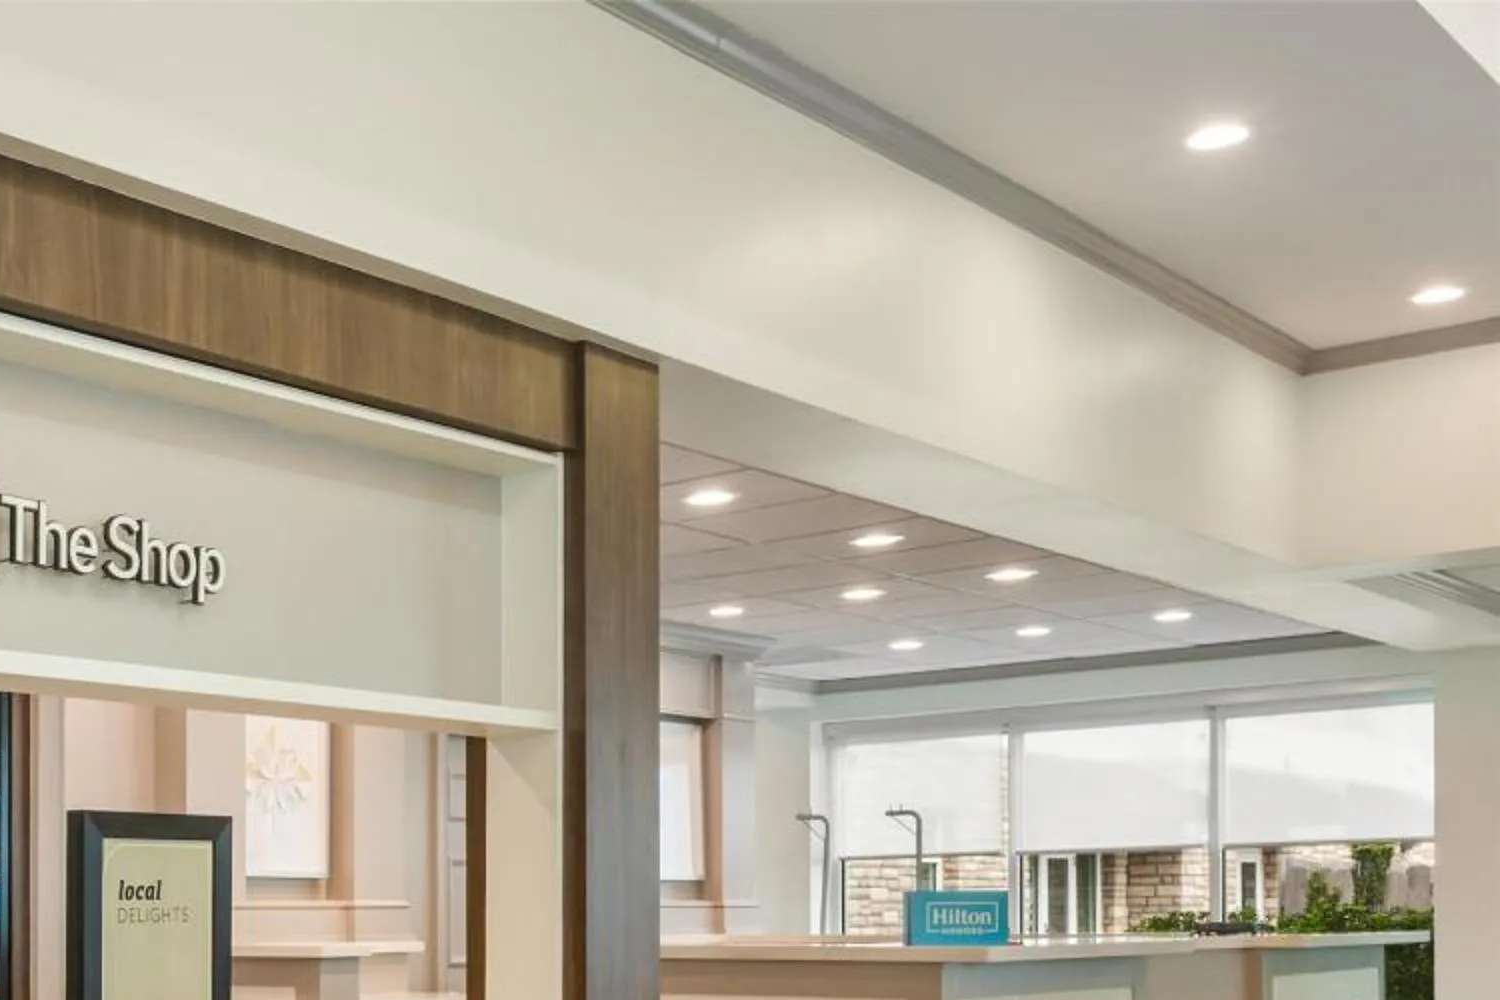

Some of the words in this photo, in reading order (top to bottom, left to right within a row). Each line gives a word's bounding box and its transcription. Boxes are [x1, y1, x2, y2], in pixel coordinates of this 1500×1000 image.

[102, 513, 227, 605] Shop
[118, 880, 163, 901] local
[117, 906, 190, 924] DELIGHTS
[931, 907, 992, 925] Hilton
